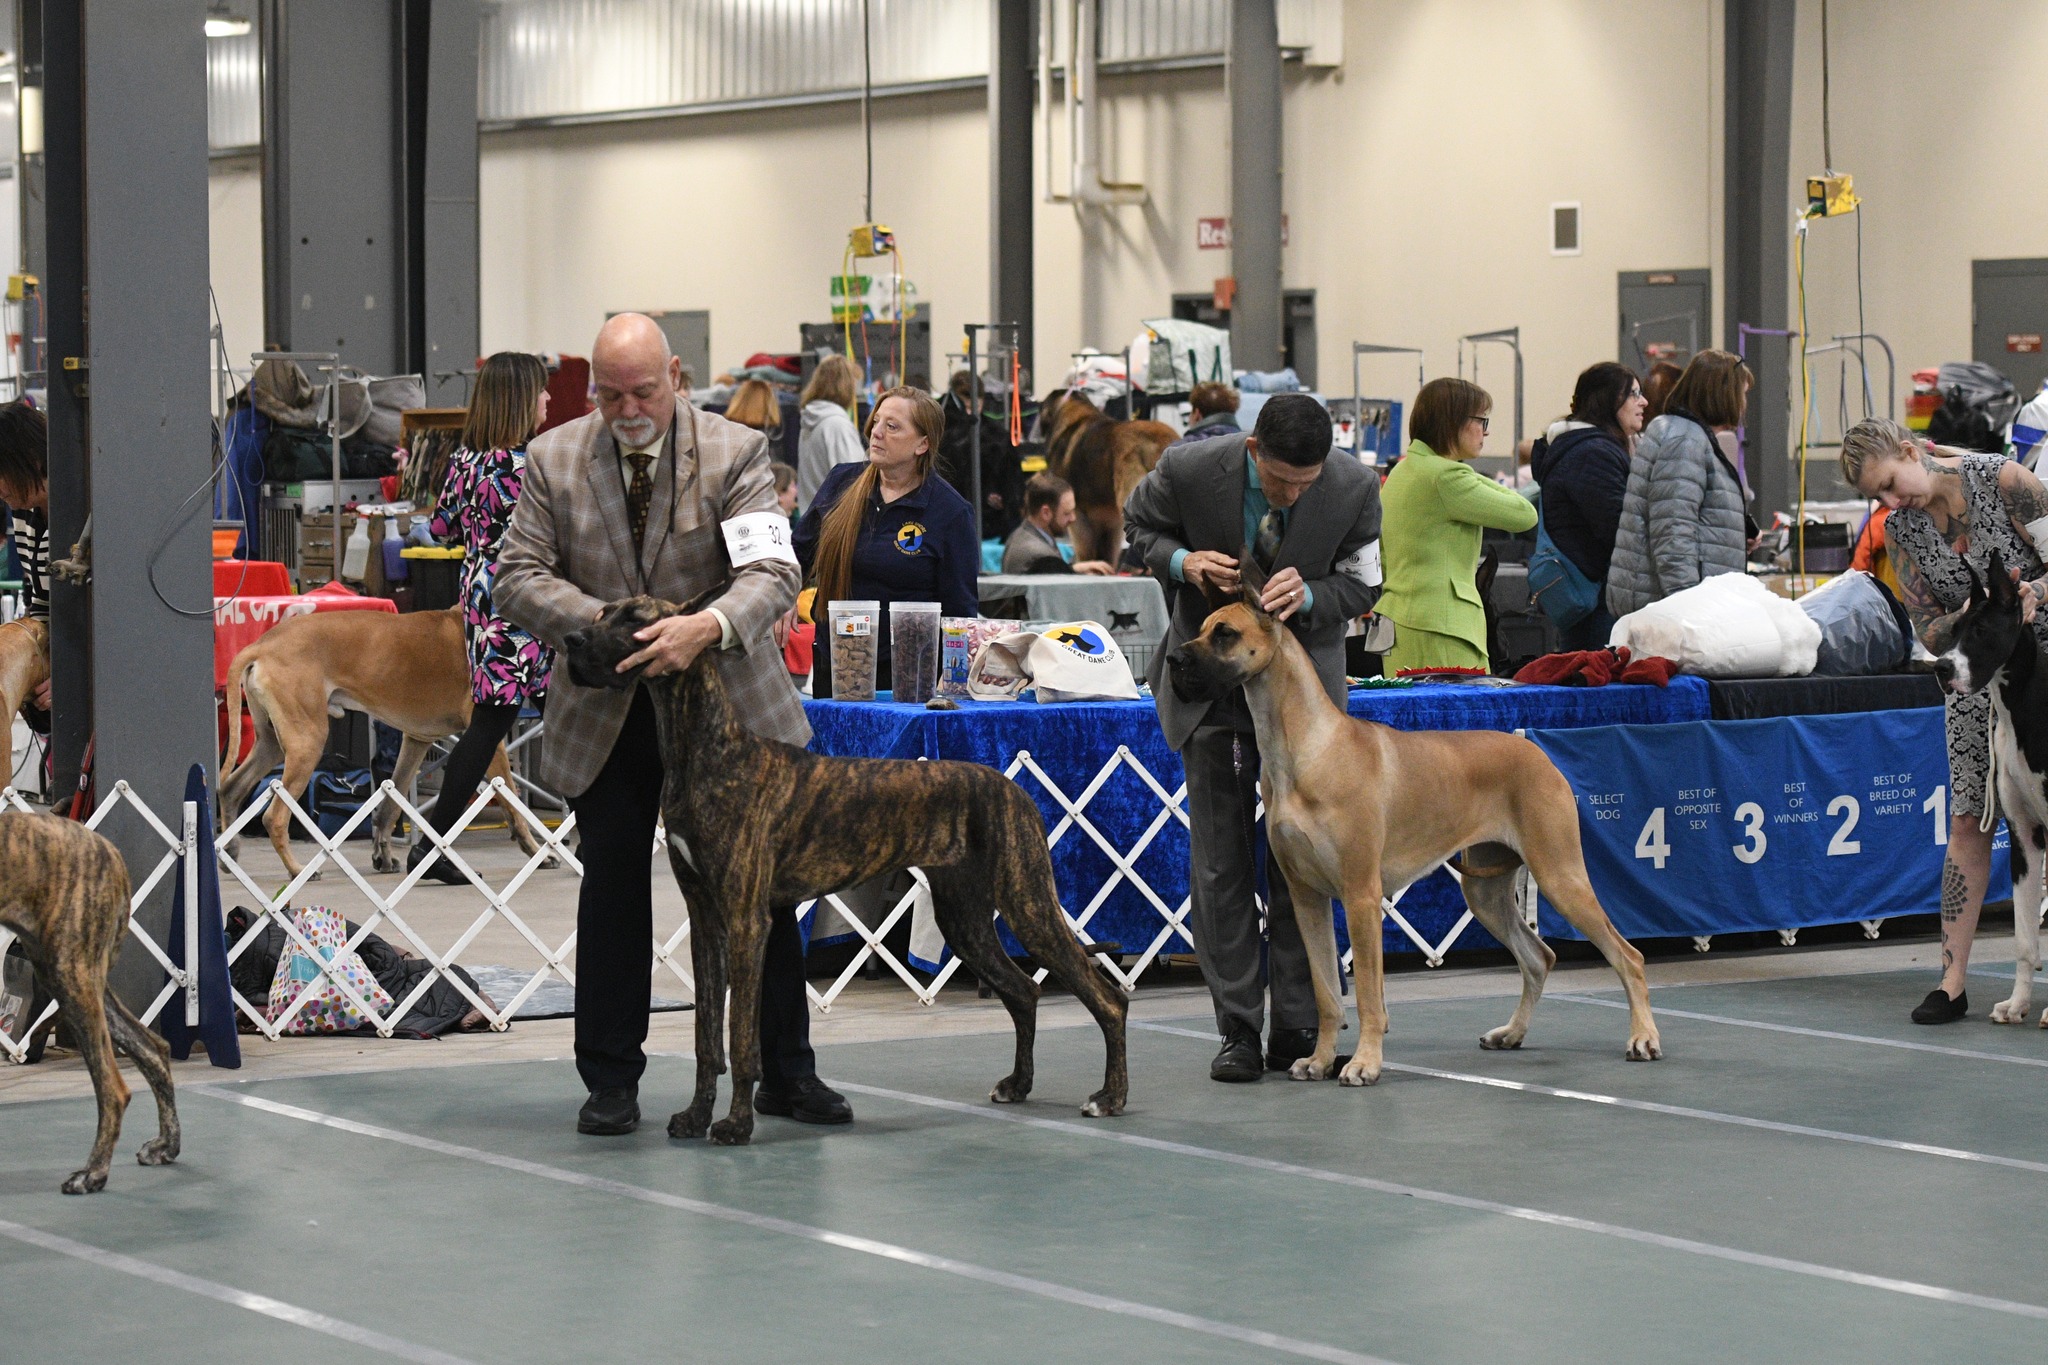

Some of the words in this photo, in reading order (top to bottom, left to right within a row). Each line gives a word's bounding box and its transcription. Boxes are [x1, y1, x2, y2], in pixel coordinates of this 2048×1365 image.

[768, 524, 783, 546] 32
[1061, 644, 1087, 660] GREAT
[1088, 655, 1107, 665] DANE
[1104, 648, 1116, 662] CLUB
[1873, 774, 1896, 787] BEST
[1898, 773, 1913, 785] OF
[1678, 788, 1702, 800] BEST
[1703, 787, 1718, 799] OF
[1784, 782, 1806, 794] BEST
[1869, 789, 1900, 802] BREED
[1901, 787, 1917, 799] OR
[1588, 793, 1625, 805] SELECT
[1788, 797, 1804, 808] OF
[1595, 809, 1621, 820] DOG
[1674, 803, 1721, 816] OPPOSITE
[1873, 802, 1914, 816] VARIETY
[1923, 784, 1948, 846] 1
[1689, 819, 1708, 830] SEX
[1773, 811, 1820, 825] WINNERS
[1732, 801, 1768, 864] 3
[1826, 794, 1861, 857] 2
[1634, 807, 1671, 870] 4
[1991, 839, 2012, 850] akc.
